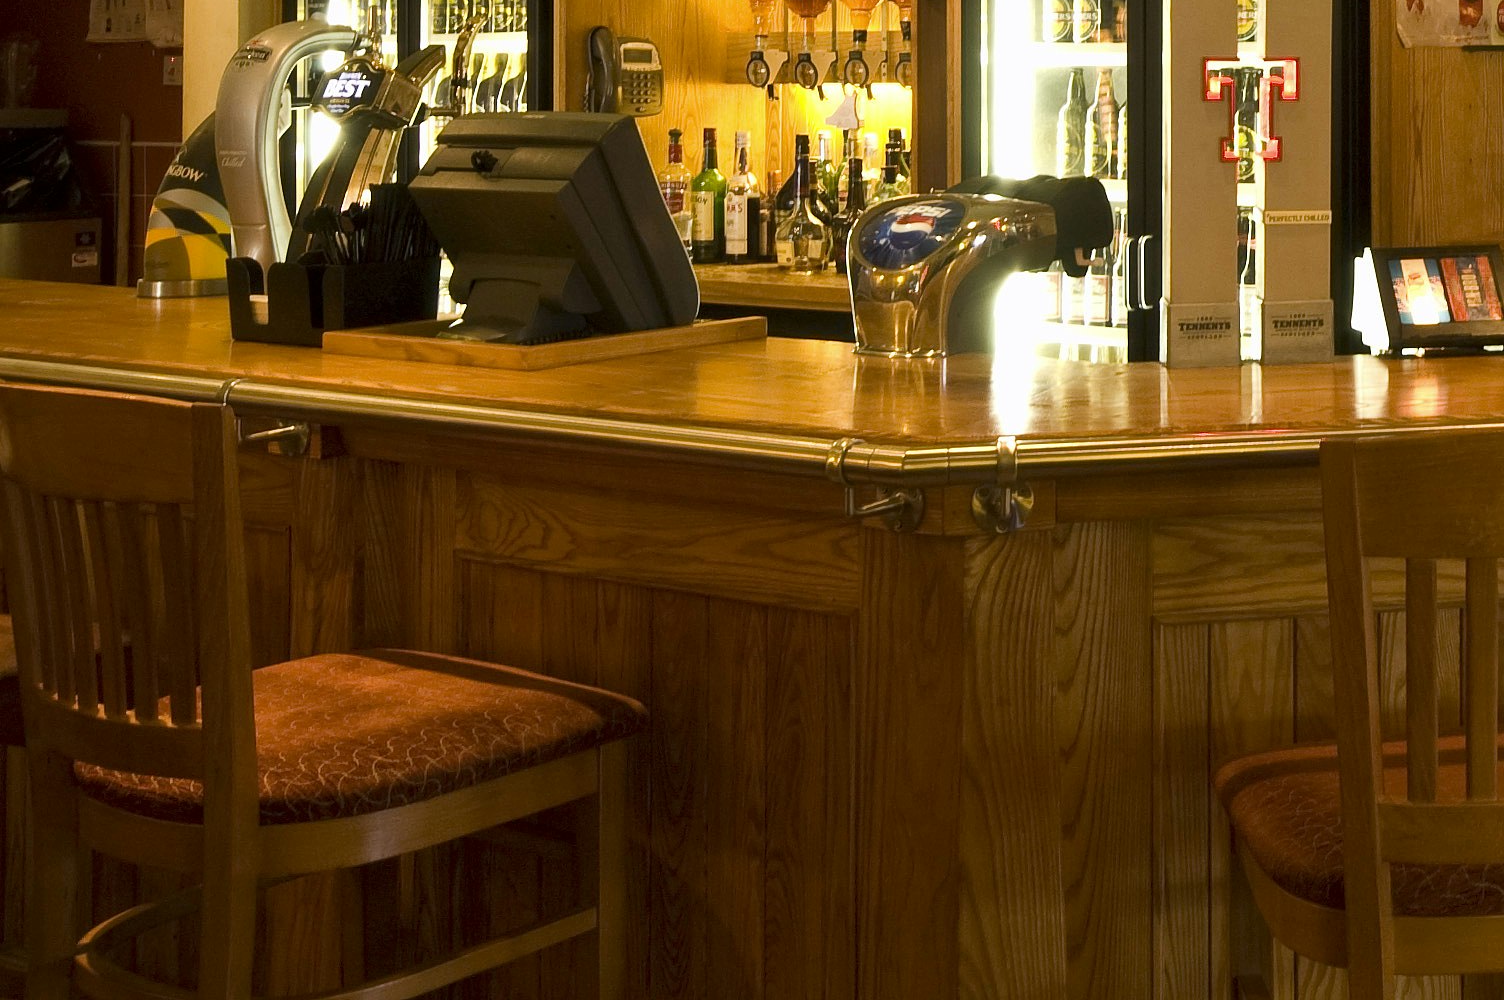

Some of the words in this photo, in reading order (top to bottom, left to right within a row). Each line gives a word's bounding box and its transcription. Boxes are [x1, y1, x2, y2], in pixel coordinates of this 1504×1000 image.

[322, 78, 372, 99] BEST
[166, 164, 205, 182] NGBOW
[886, 205, 952, 218] PEPSI
[1178, 319, 1231, 332] TENNENT'S
[1272, 317, 1325, 329] TENNENT'S
